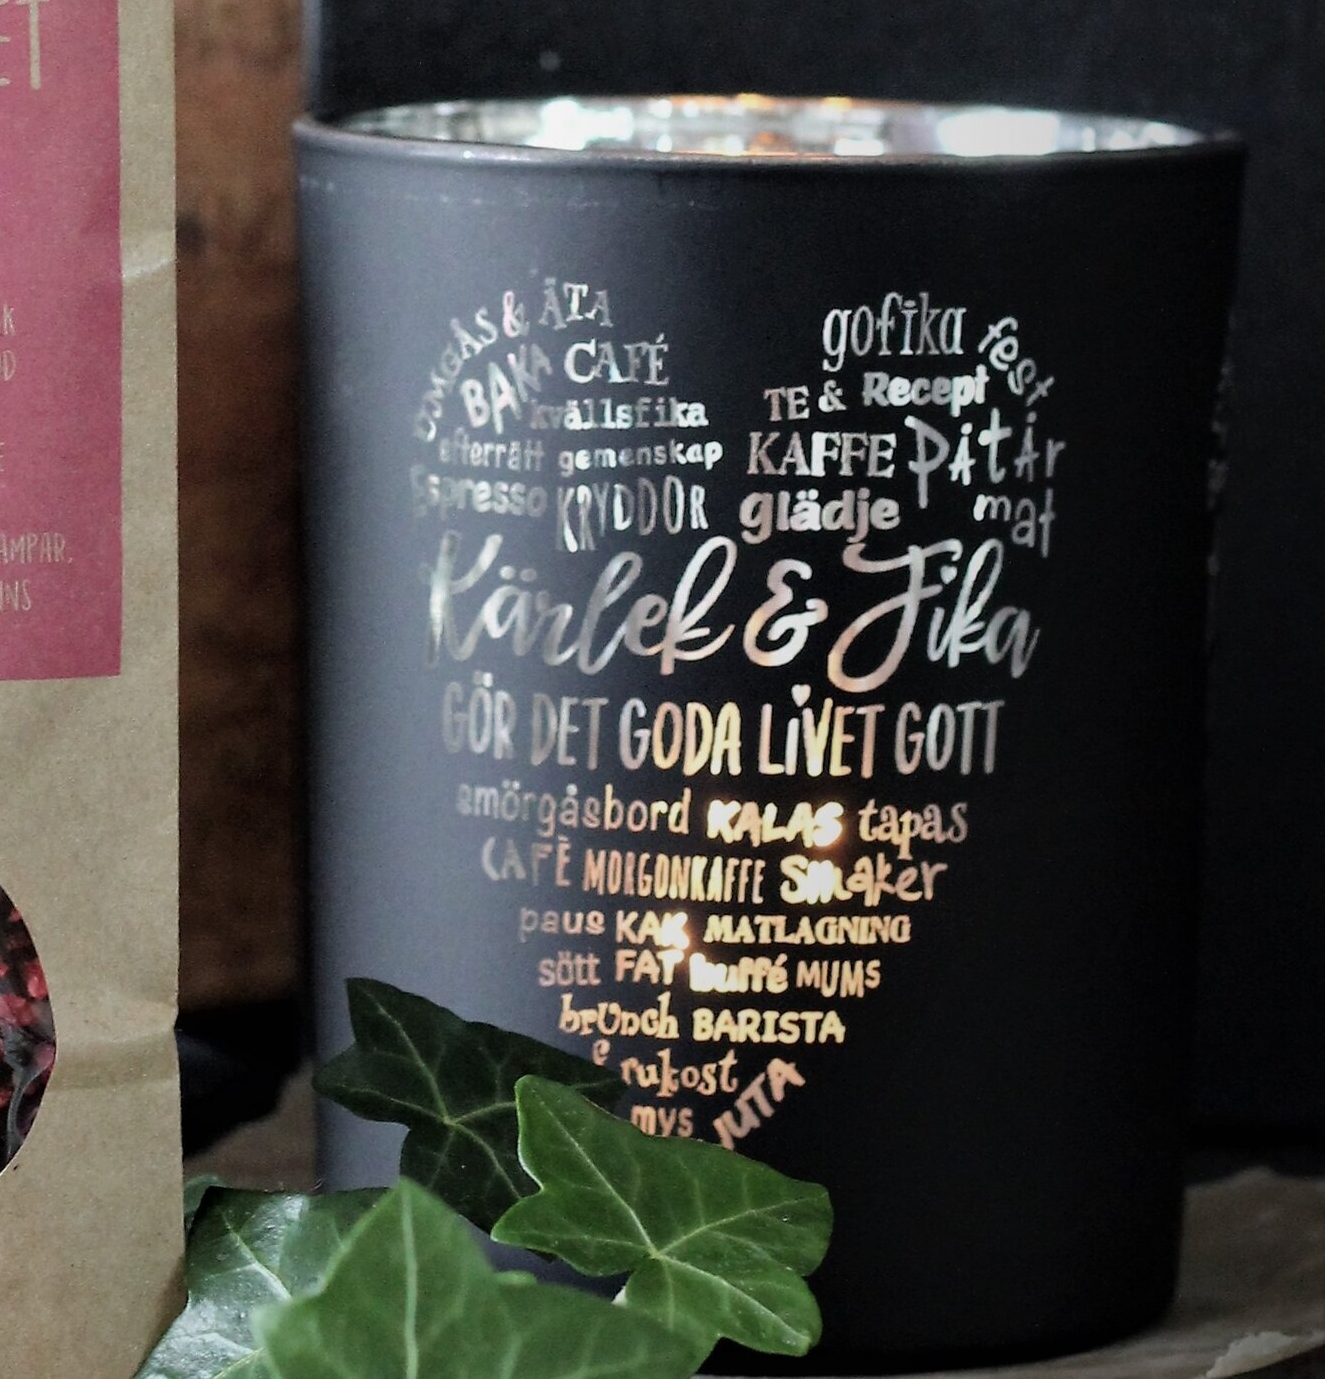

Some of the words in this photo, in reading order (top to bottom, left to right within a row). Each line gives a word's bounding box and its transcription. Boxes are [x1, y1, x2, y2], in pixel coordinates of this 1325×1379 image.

[539, 277, 613, 330] ÄTA
[822, 291, 967, 372] gofika
[564, 333, 669, 386] CAFÉ
[977, 316, 1055, 406] fest
[459, 343, 553, 435] BAKA
[763, 385, 810, 422] TE
[817, 379, 847, 413] &
[863, 363, 990, 418] Recept
[558, 439, 723, 478] gemenskap
[747, 431, 897, 479] KAFFE
[556, 475, 708, 553] KRYDDOR
[739, 488, 901, 544] glädje
[973, 487, 1057, 558] mat
[420, 530, 739, 676] Kärlek
[744, 558, 828, 667] &
[827, 538, 1041, 693] Fika
[444, 671, 514, 761] GÖR
[531, 697, 608, 770] DET
[619, 698, 742, 777] GODA
[894, 700, 1004, 775] GOTT
[457, 779, 692, 837] smörgåsbord
[706, 799, 846, 848] KALAS
[859, 798, 969, 861] tapas
[583, 848, 765, 905] MORGONKAFFE
[519, 907, 605, 943] paus
[703, 914, 911, 946] MATLAGNING
[538, 951, 600, 987] sött
[615, 948, 685, 985] FAT
[688, 951, 790, 995] buffé
[796, 958, 882, 999] MUMS
[692, 1006, 846, 1044] BARISTA
[631, 1104, 694, 1137] mys
